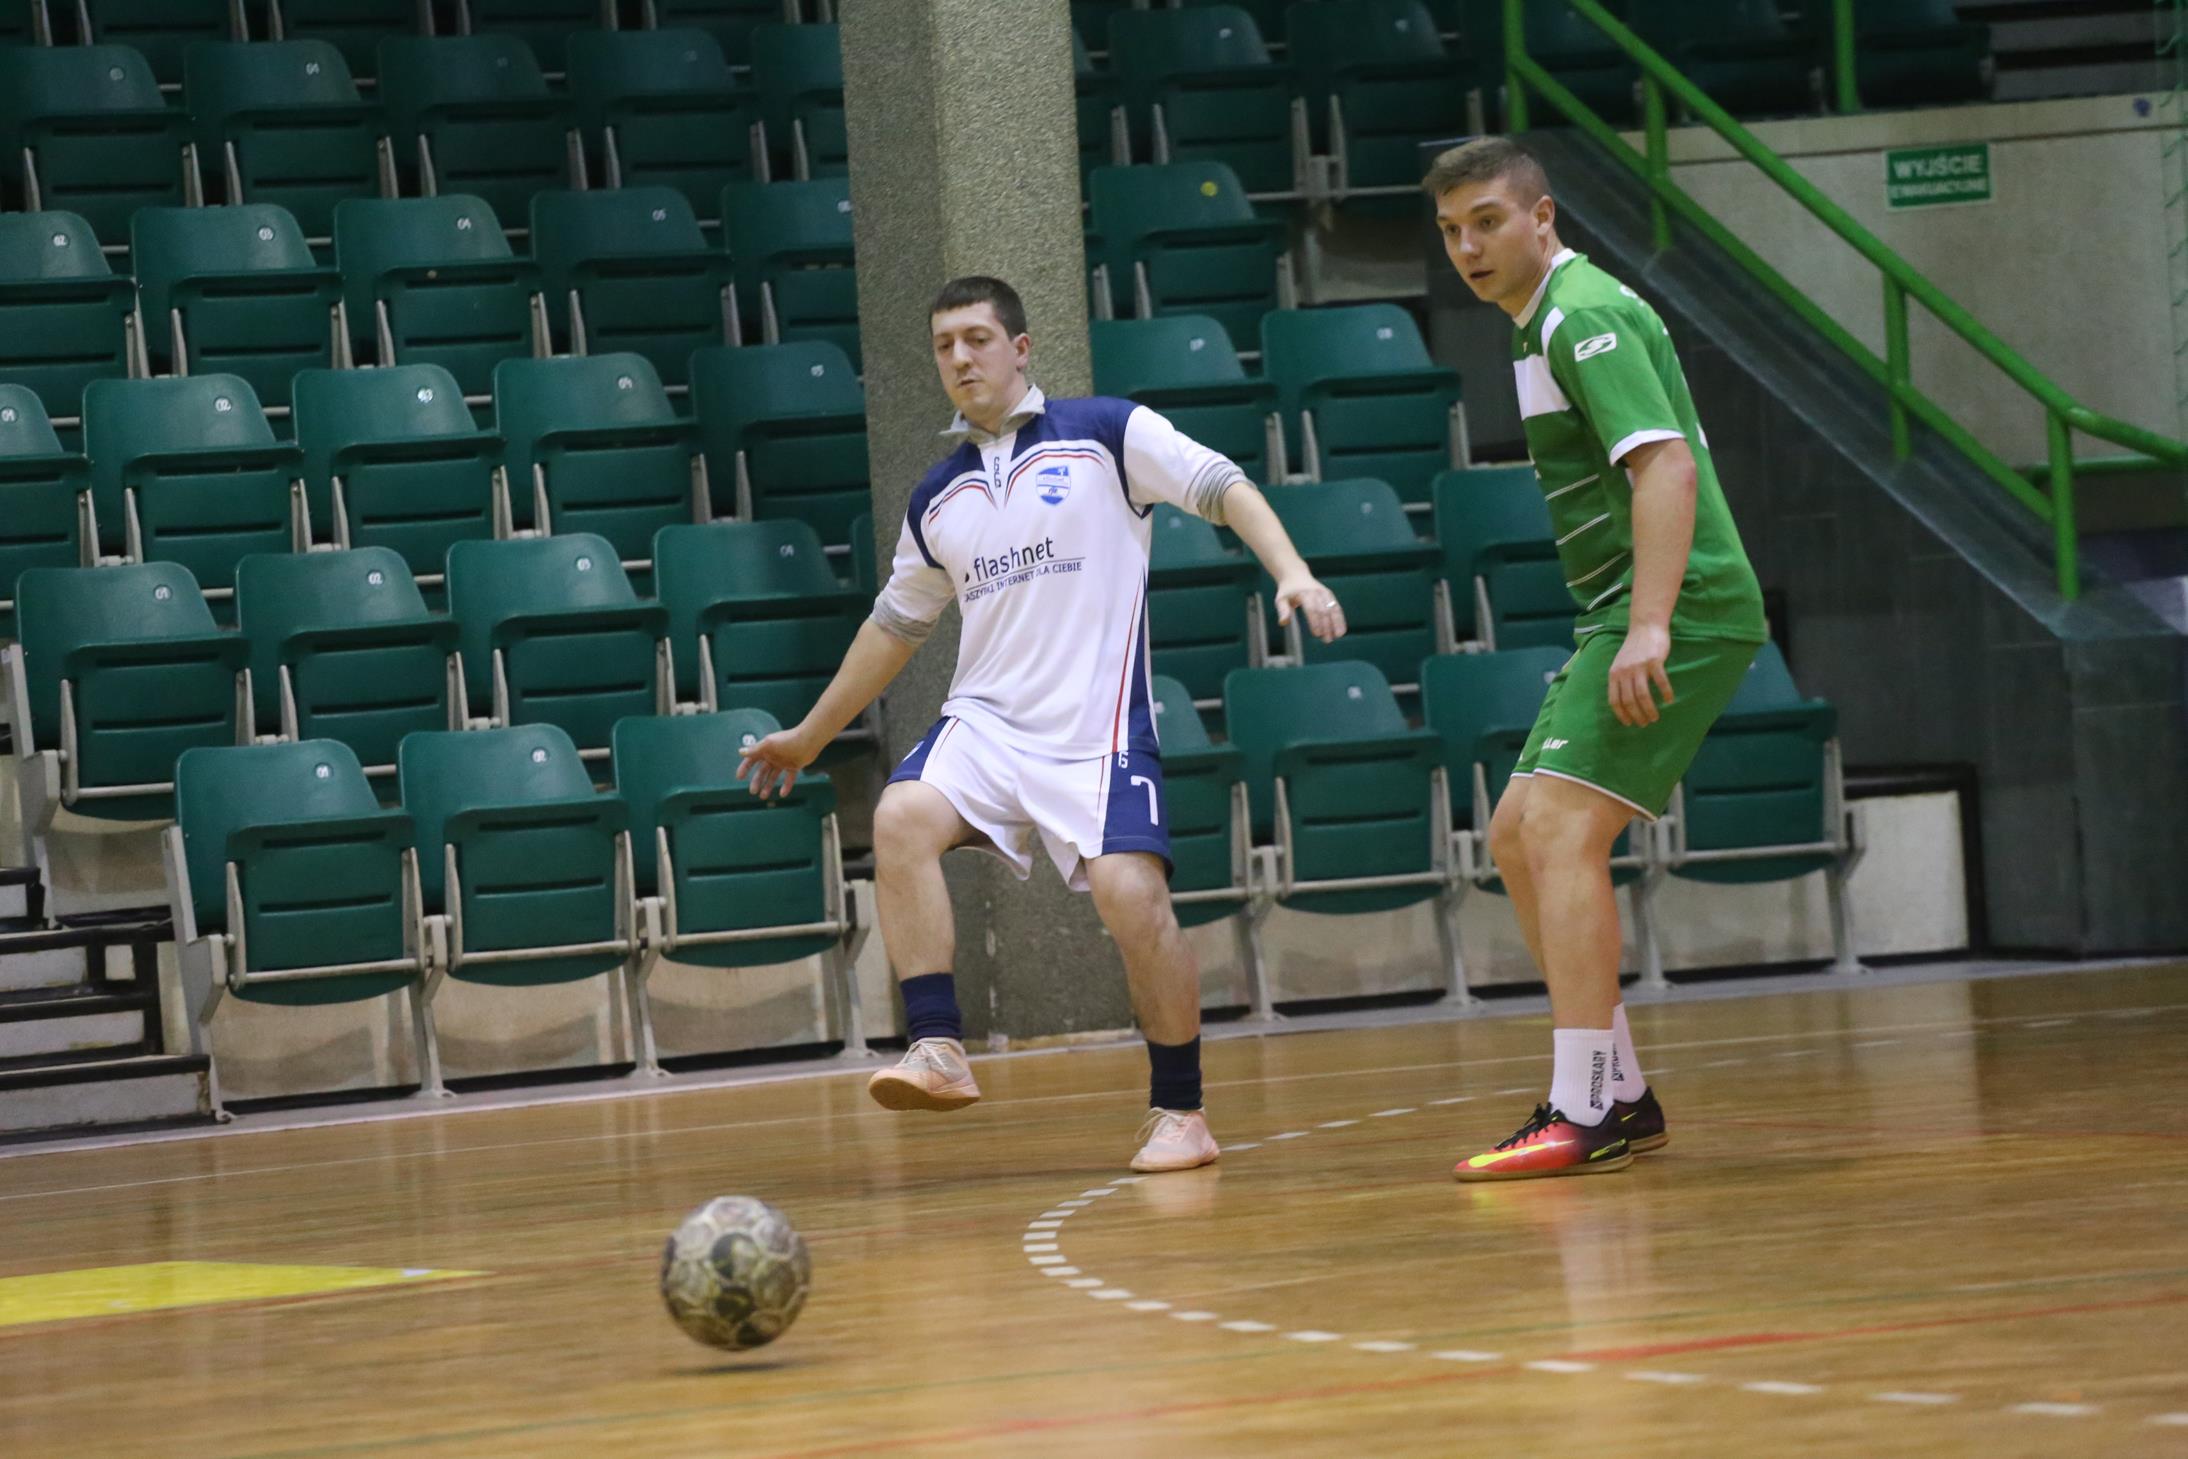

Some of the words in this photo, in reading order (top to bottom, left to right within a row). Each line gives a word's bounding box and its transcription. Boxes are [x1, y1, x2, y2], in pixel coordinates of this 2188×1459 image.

[1893, 154, 1981, 179] WYJŚCIE
[973, 537, 1054, 582] flashnet
[997, 571, 1035, 591] INTERNET
[1052, 561, 1083, 574] CIEBIE
[1130, 775, 1159, 827] 7
